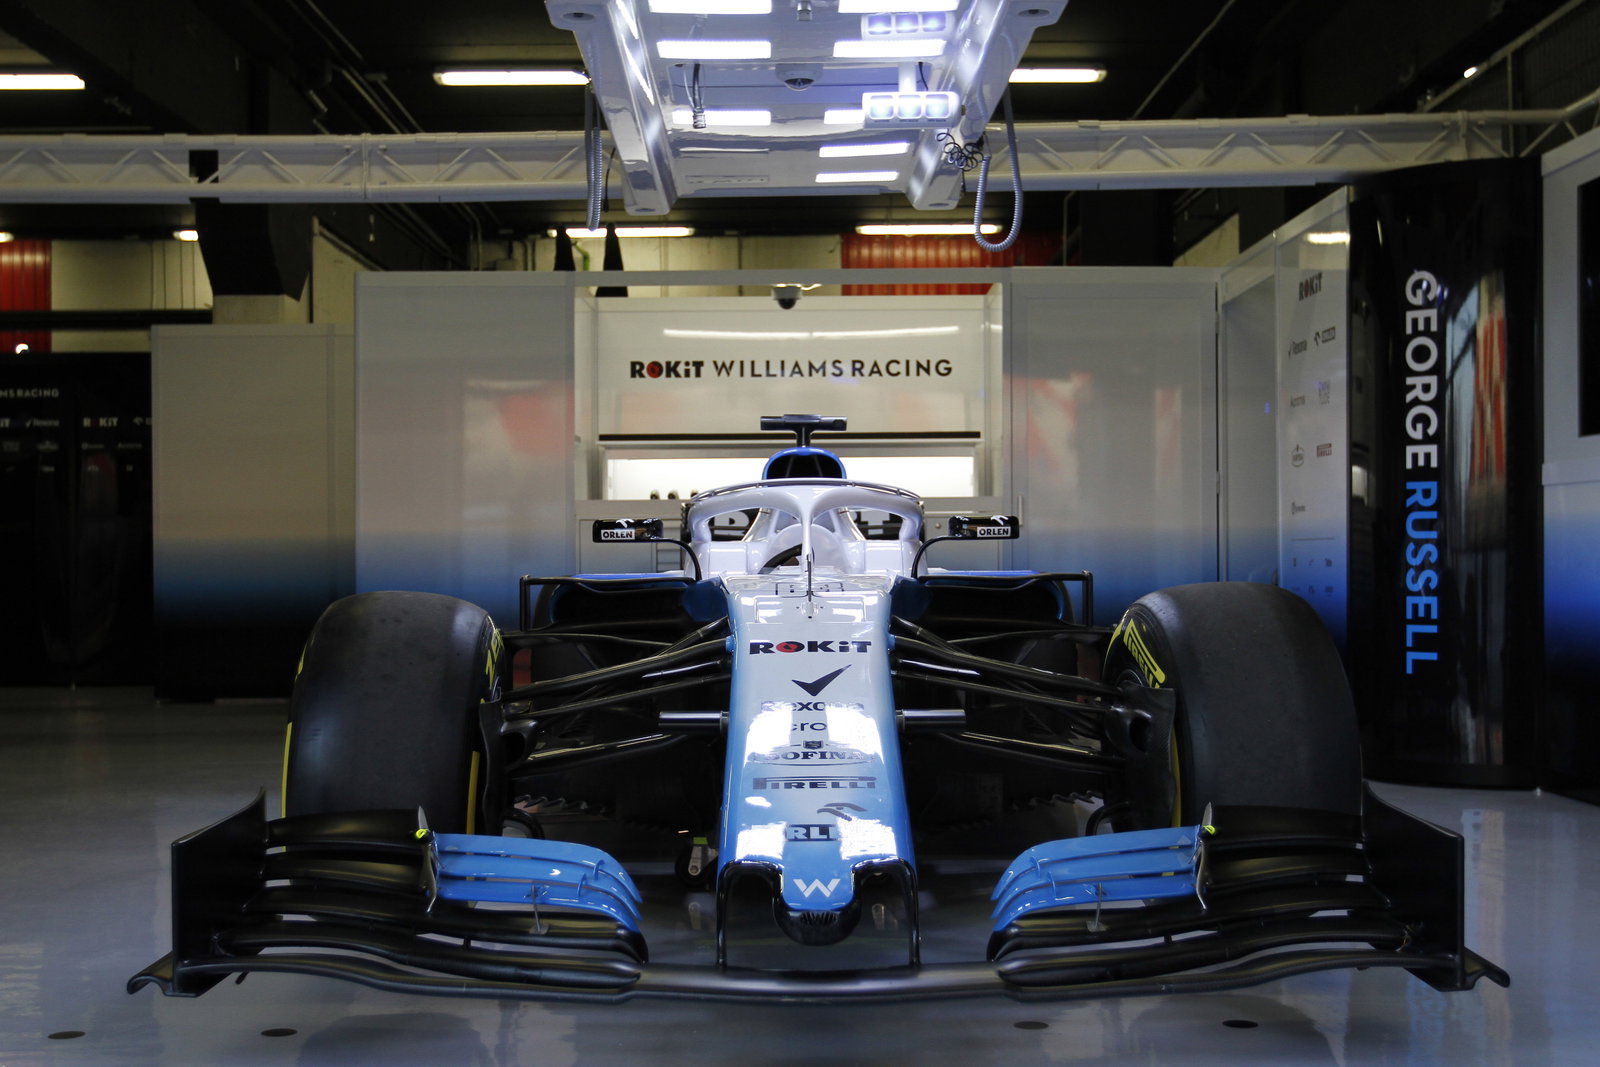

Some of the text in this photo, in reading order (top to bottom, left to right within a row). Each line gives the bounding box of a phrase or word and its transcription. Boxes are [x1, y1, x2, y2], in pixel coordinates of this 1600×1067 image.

[713, 359, 844, 378] WILLIAMS
[851, 359, 953, 378] RACING
[17, 388, 60, 398] RACING
[1405, 270, 1438, 675] GEORGE RUSSELL
[602, 531, 633, 539] ORLEN
[979, 528, 1009, 536] ORLEN
[752, 776, 877, 790] PIRELLI
